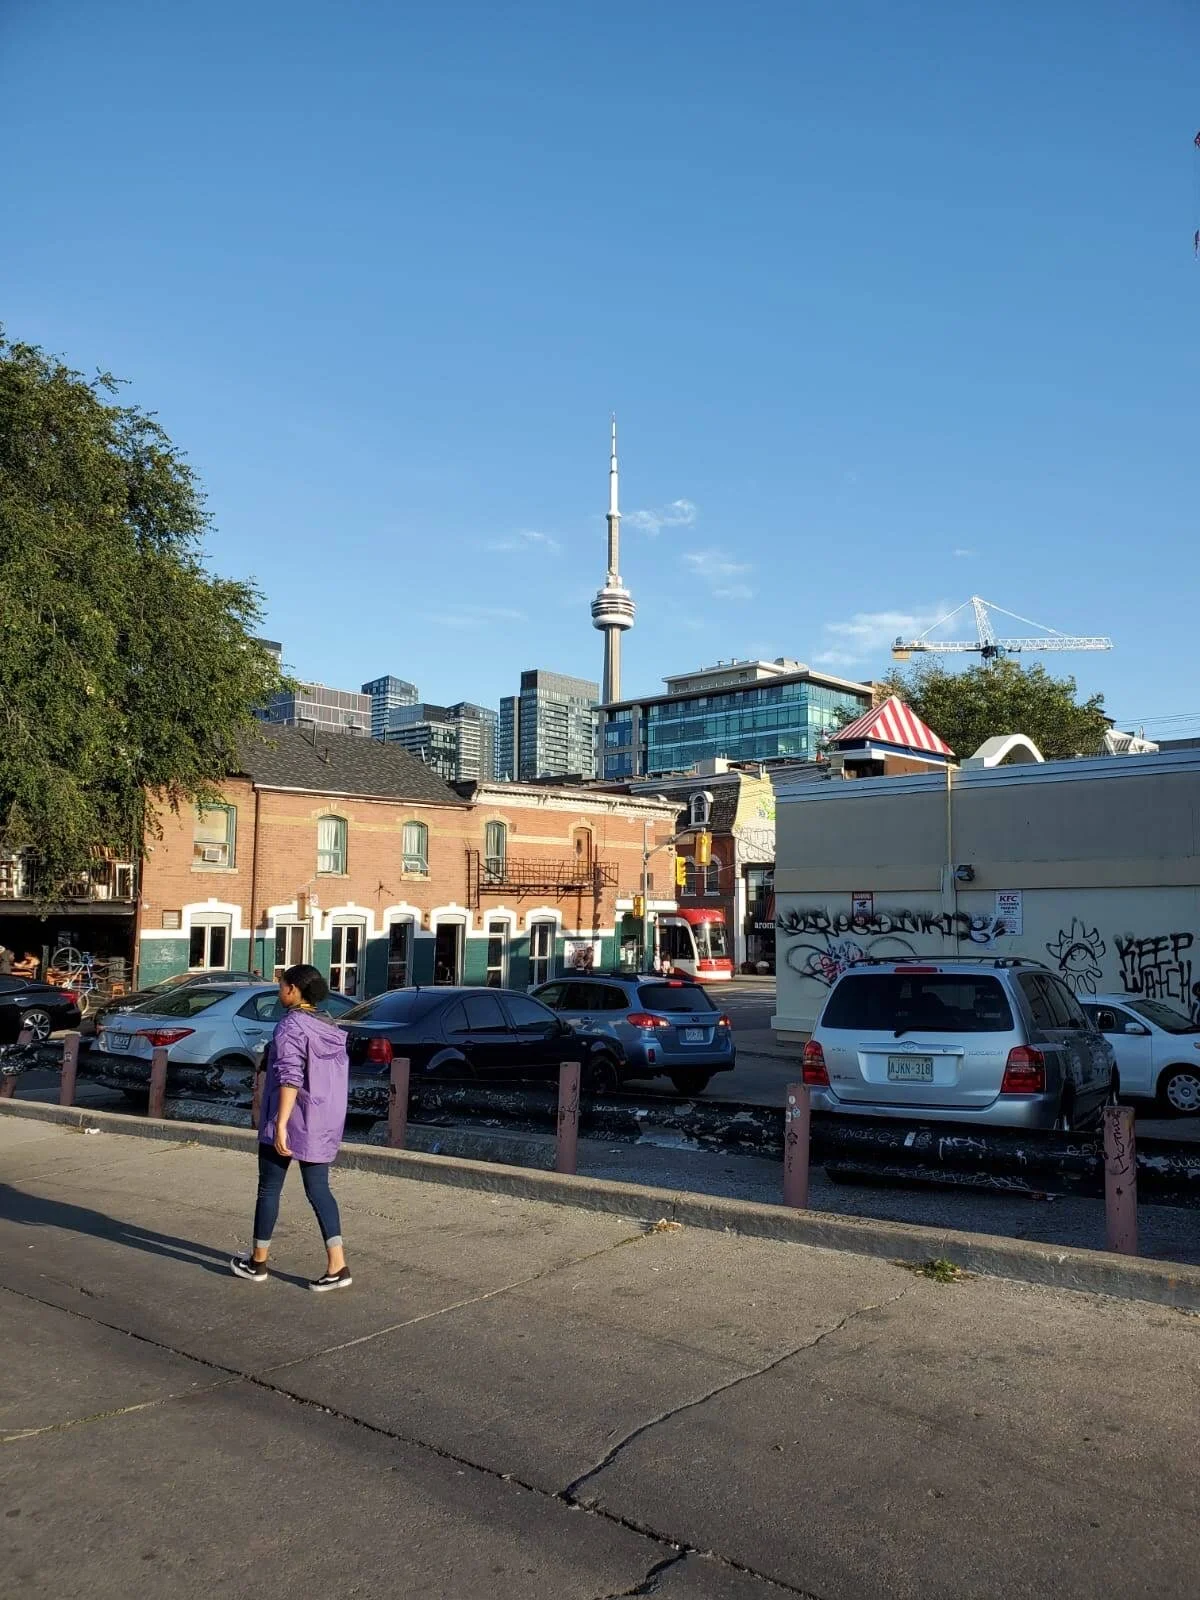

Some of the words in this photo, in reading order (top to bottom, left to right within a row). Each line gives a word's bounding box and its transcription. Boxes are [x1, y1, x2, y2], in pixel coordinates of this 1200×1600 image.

[754, 920, 775, 929] arom
[1113, 932, 1194, 974] KEEP
[1119, 959, 1192, 1006] WATCH
